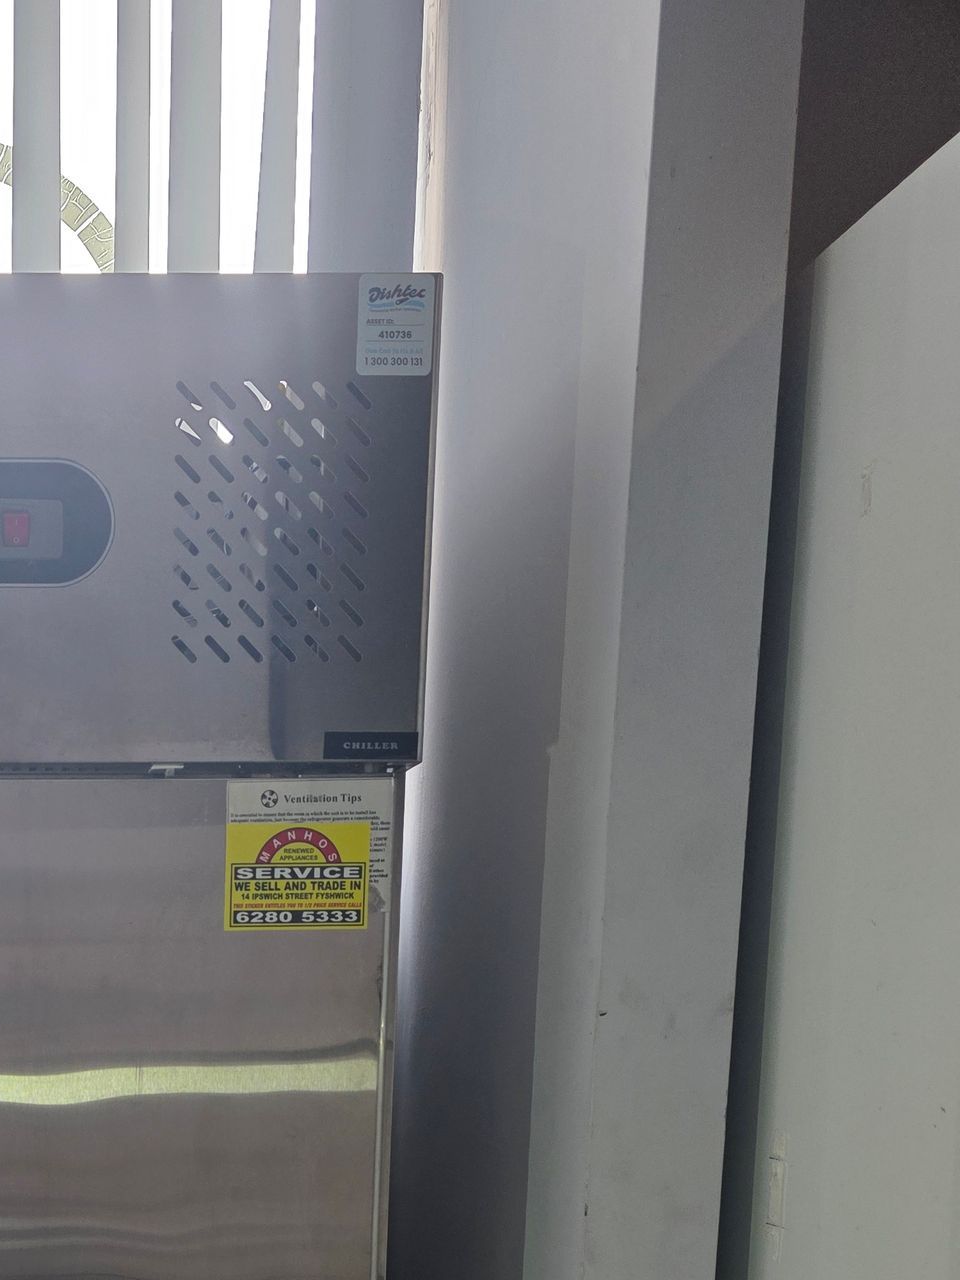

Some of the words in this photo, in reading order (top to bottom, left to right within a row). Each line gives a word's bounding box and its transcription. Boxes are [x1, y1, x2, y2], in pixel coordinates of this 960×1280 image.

[378, 330, 412, 339] 410736
[371, 357, 388, 366] 300
[391, 357, 408, 366] 300
[411, 357, 423, 366] 131
[284, 794, 338, 803] Ventilation
[341, 793, 362, 803] Tips
[260, 829, 338, 863] MANHOS
[236, 867, 360, 879] SERVICE
[234, 882, 251, 891] WE
[254, 882, 281, 891] SELL
[284, 881, 307, 891] AND
[311, 881, 346, 890] TRADE
[350, 881, 361, 890] IN
[285, 892, 313, 900] STREET
[316, 892, 354, 900] FYSHWICK
[236, 912, 293, 923] 6280
[302, 911, 358, 922] 5333
